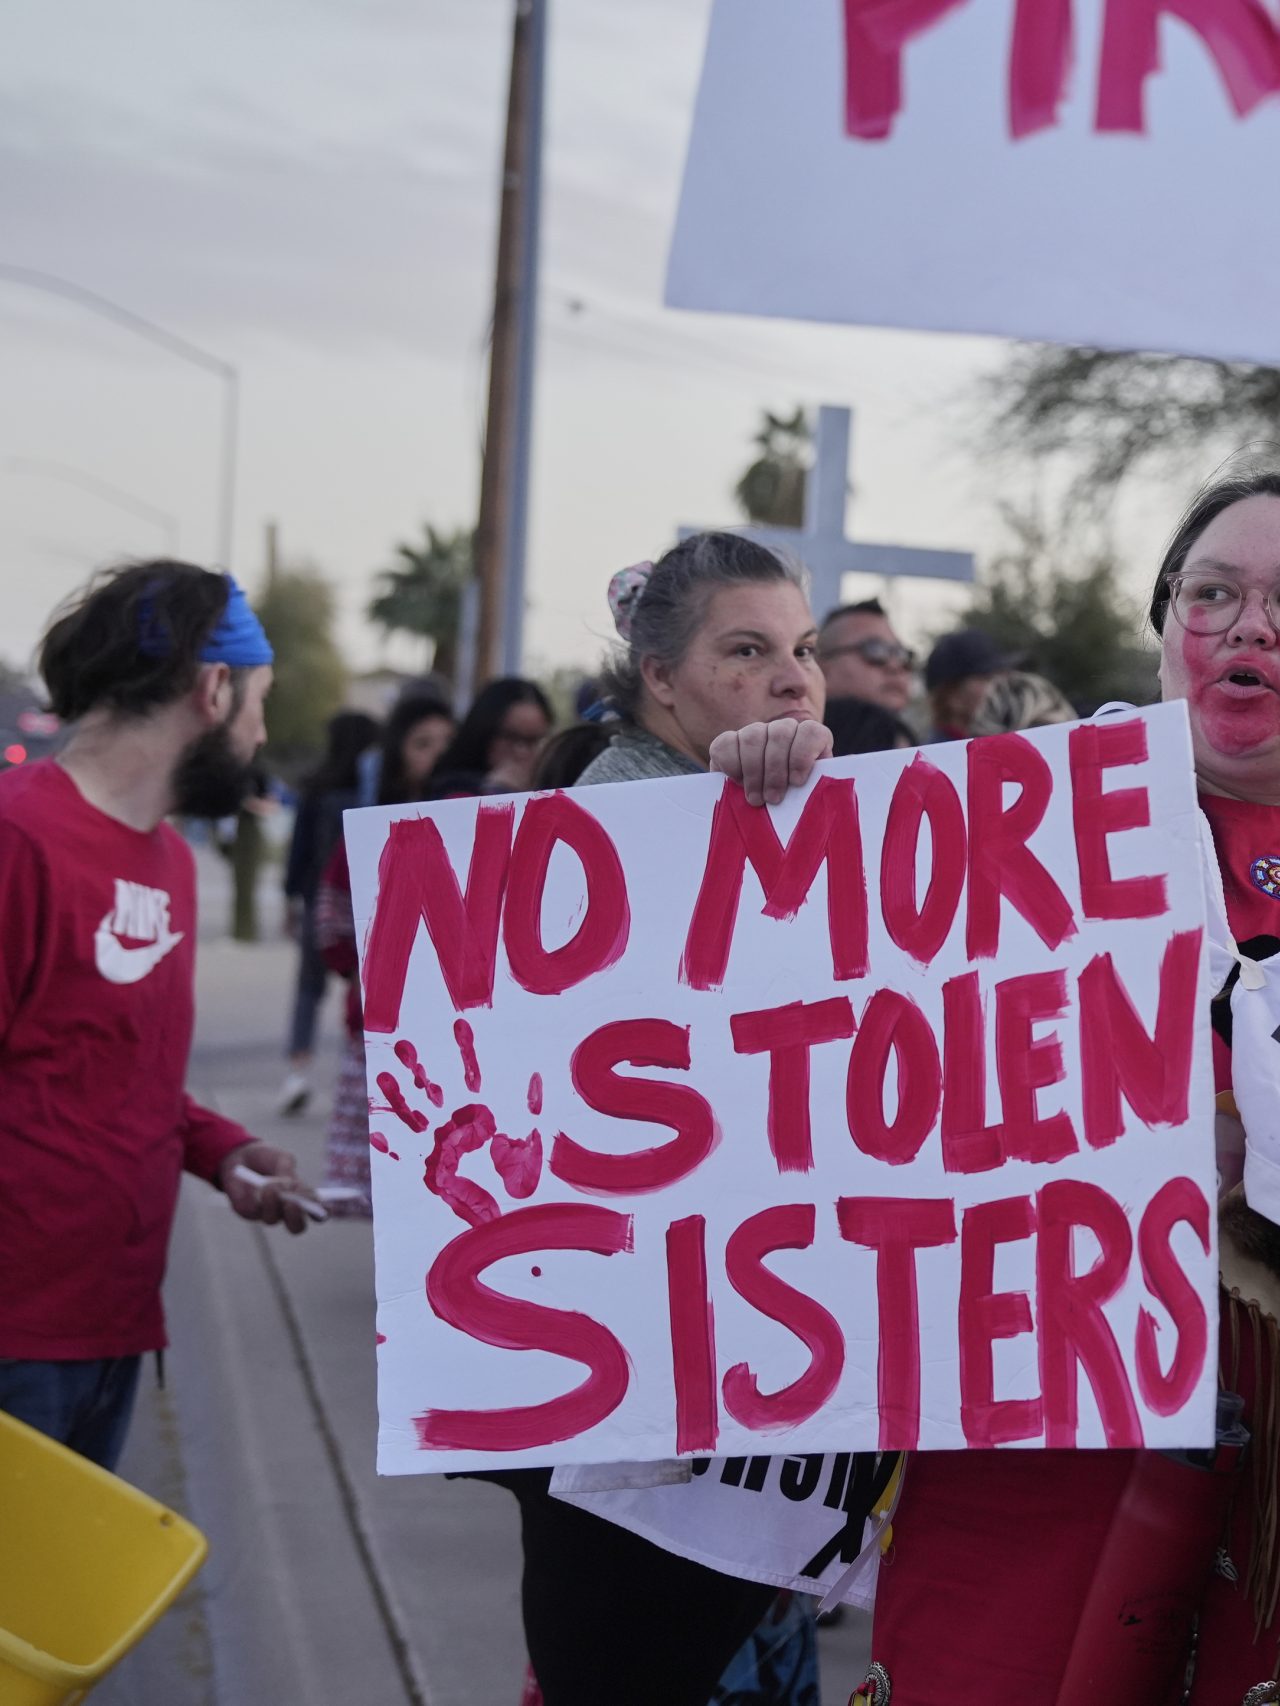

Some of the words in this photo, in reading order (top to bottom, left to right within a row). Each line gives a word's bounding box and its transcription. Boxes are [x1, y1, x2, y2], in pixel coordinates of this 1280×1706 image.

[112, 876, 171, 941] NIKE
[361, 788, 631, 1032] NO
[680, 717, 1170, 991] MORE
[549, 928, 1204, 1194] STOLEN
[413, 1176, 1211, 1455] SISTERS
